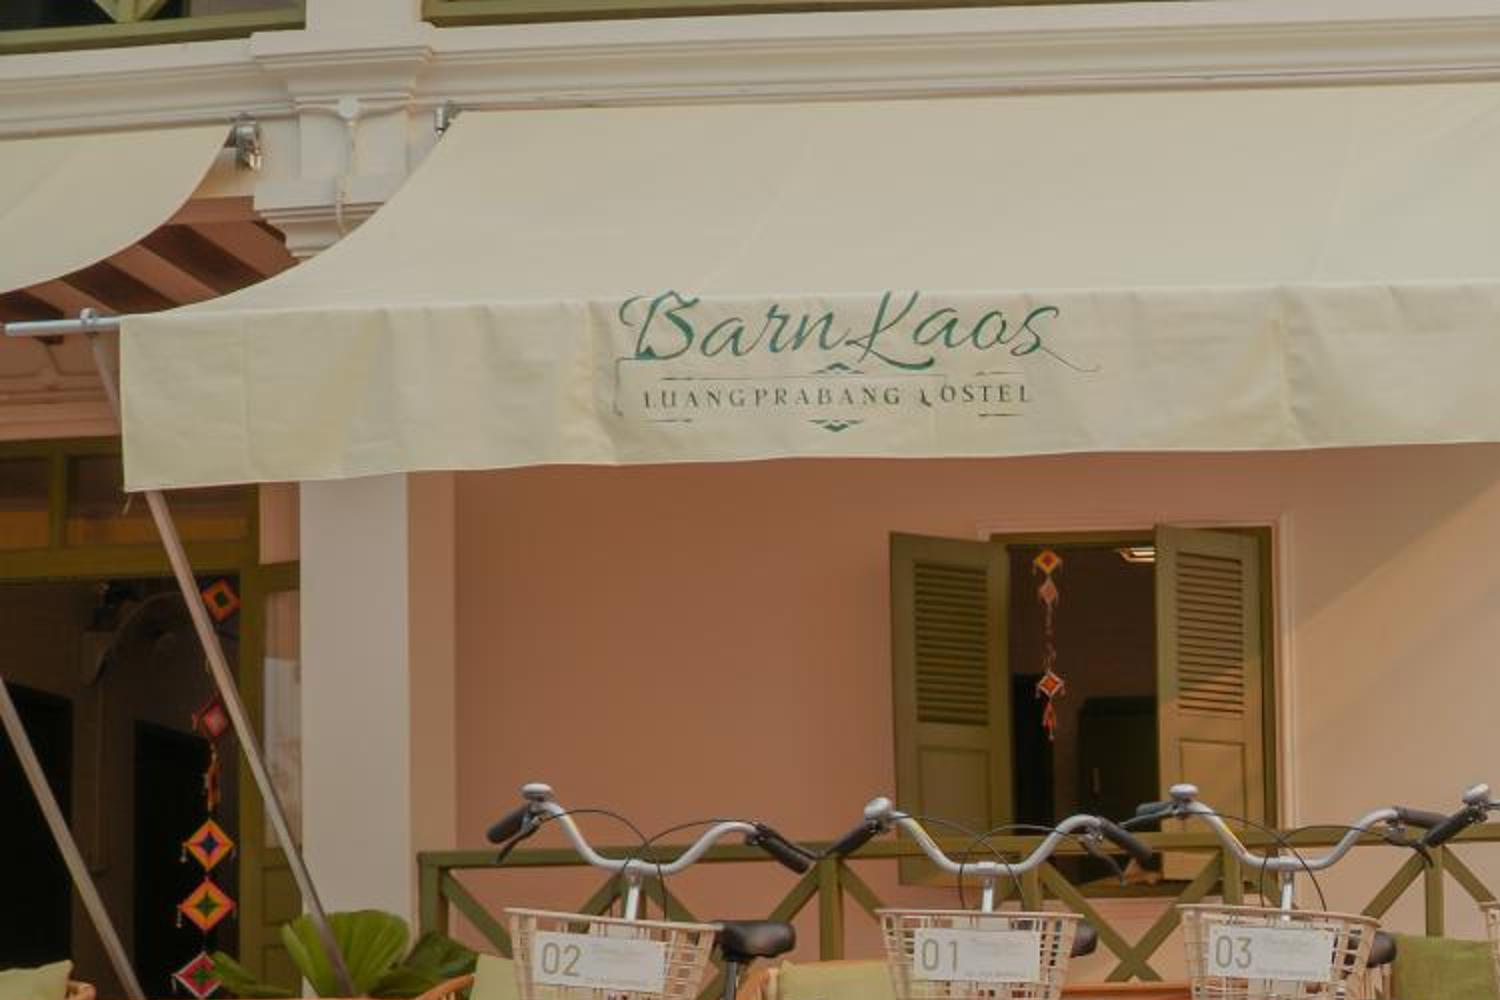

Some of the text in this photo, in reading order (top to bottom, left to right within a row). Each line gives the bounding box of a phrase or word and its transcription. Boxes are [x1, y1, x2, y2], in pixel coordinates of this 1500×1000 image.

[541, 942, 582, 977] 02
[921, 938, 959, 972] 01
[1214, 935, 1253, 969] 03
